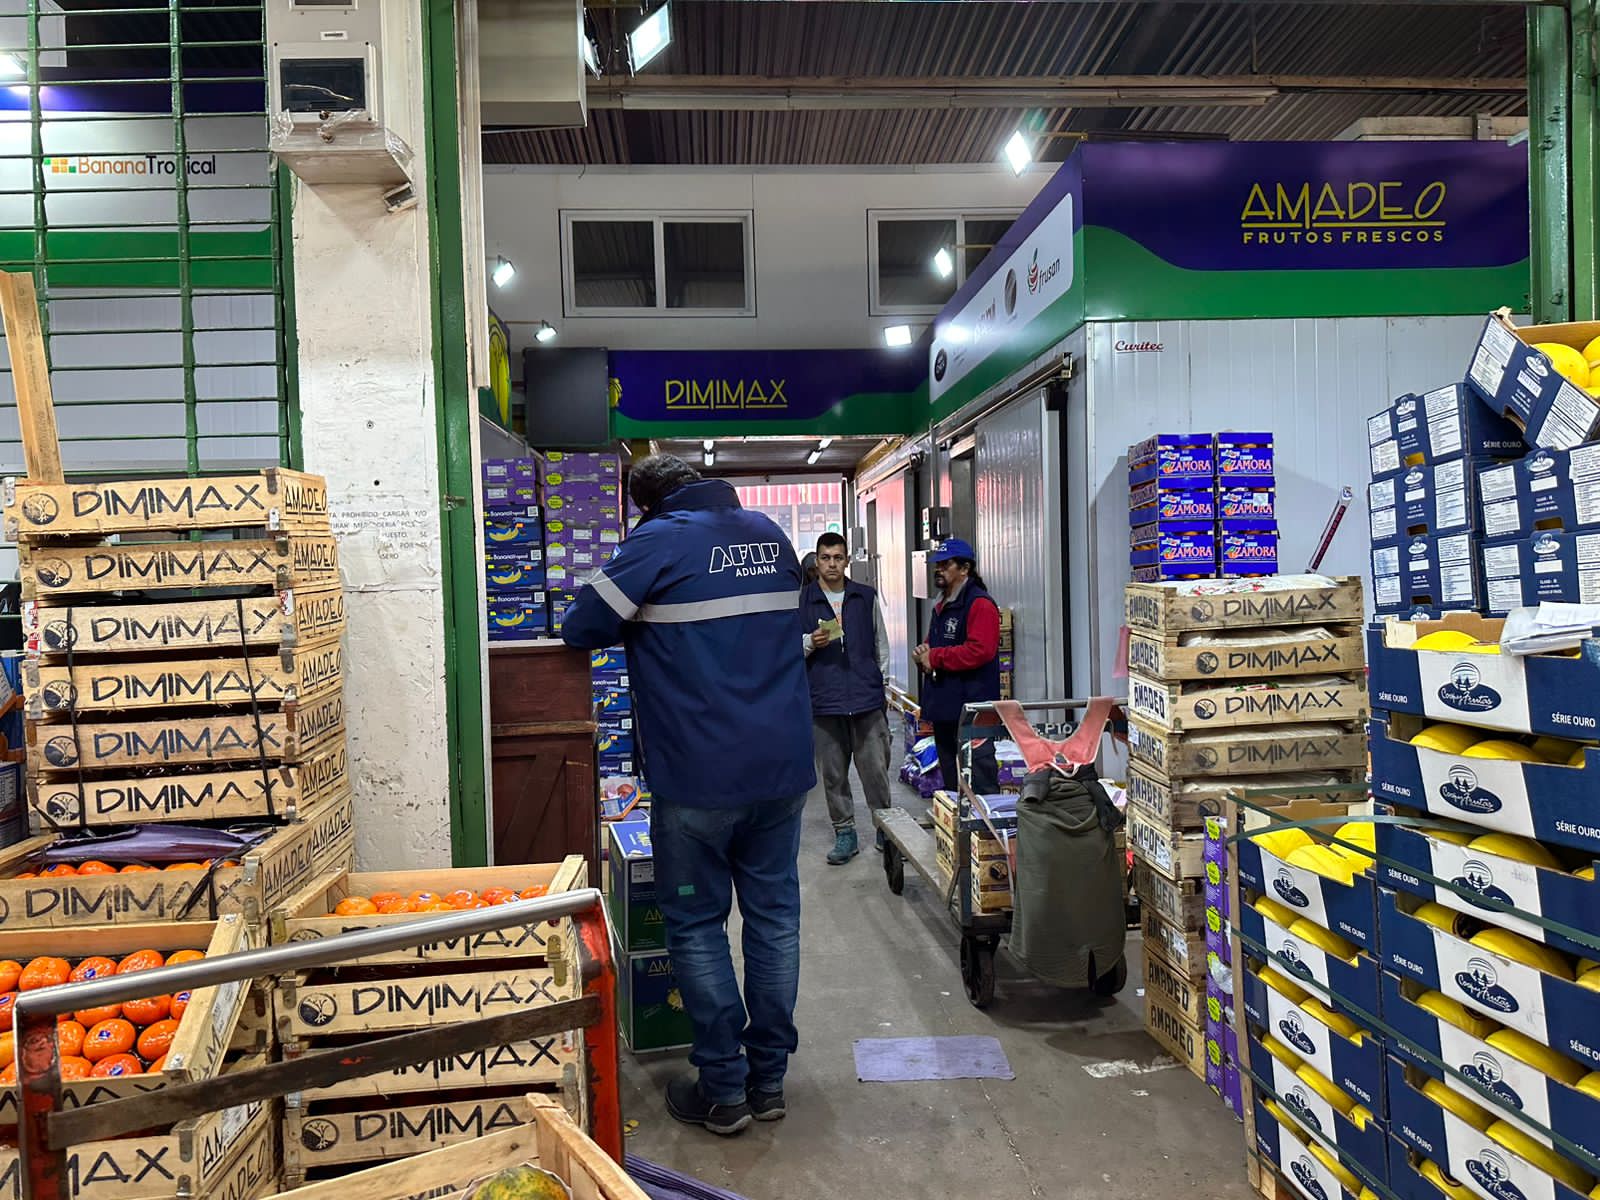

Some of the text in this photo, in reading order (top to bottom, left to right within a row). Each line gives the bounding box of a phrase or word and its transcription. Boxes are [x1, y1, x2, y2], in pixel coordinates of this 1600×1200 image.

[78, 155, 216, 175] BananaTroical
[1241, 181, 1446, 228] AMADEO
[1243, 230, 1443, 244] FRUTOS FRESCOS
[1114, 339, 1165, 351] Curitec
[665, 379, 788, 409] DIMIMAX
[1171, 460, 1211, 471] ZAMORA
[1231, 459, 1271, 470] ZAMORA
[72, 484, 265, 520] DIMIMAX
[285, 485, 327, 514] AMADEO
[1171, 504, 1212, 514] ZAMORA
[294, 541, 337, 570] AMADEO
[709, 542, 780, 574] AFIP
[1171, 547, 1213, 557] ZAMORA
[1234, 546, 1276, 557] ZAMORA
[85, 548, 277, 582] DIMIMAX
[735, 564, 778, 577] ADUANA
[299, 595, 345, 626] AMADEO
[1224, 593, 1337, 618] DIMIMAX
[91, 609, 279, 645] DIMIMAX
[302, 648, 342, 688] AMADEO
[1228, 643, 1341, 670] DIMIMAX
[92, 670, 284, 702] DIMIMAX
[1392, 694, 1408, 704] OURO
[1134, 684, 1165, 719] AMADEO
[1225, 690, 1343, 715] DIMIMAX
[300, 699, 342, 741] AMADEO
[1551, 712, 1596, 728] SÉRIE OURO
[94, 723, 281, 760] DIMIMAX
[1228, 740, 1343, 764] DIMIMAX
[301, 749, 345, 799] AMADEO
[1394, 785, 1411, 797] OURO
[313, 800, 353, 853] AMADEO
[1555, 820, 1600, 840] SÉRIE OURO
[264, 839, 312, 903] AMADEO
[1402, 873, 1419, 886] OURO
[1407, 959, 1424, 975] OURO
[352, 976, 558, 1016] DIMIMAX
[1151, 1005, 1194, 1060] AMADEO
[1569, 1039, 1591, 1058] SÉRIE
[1417, 1133, 1433, 1152] OURO
